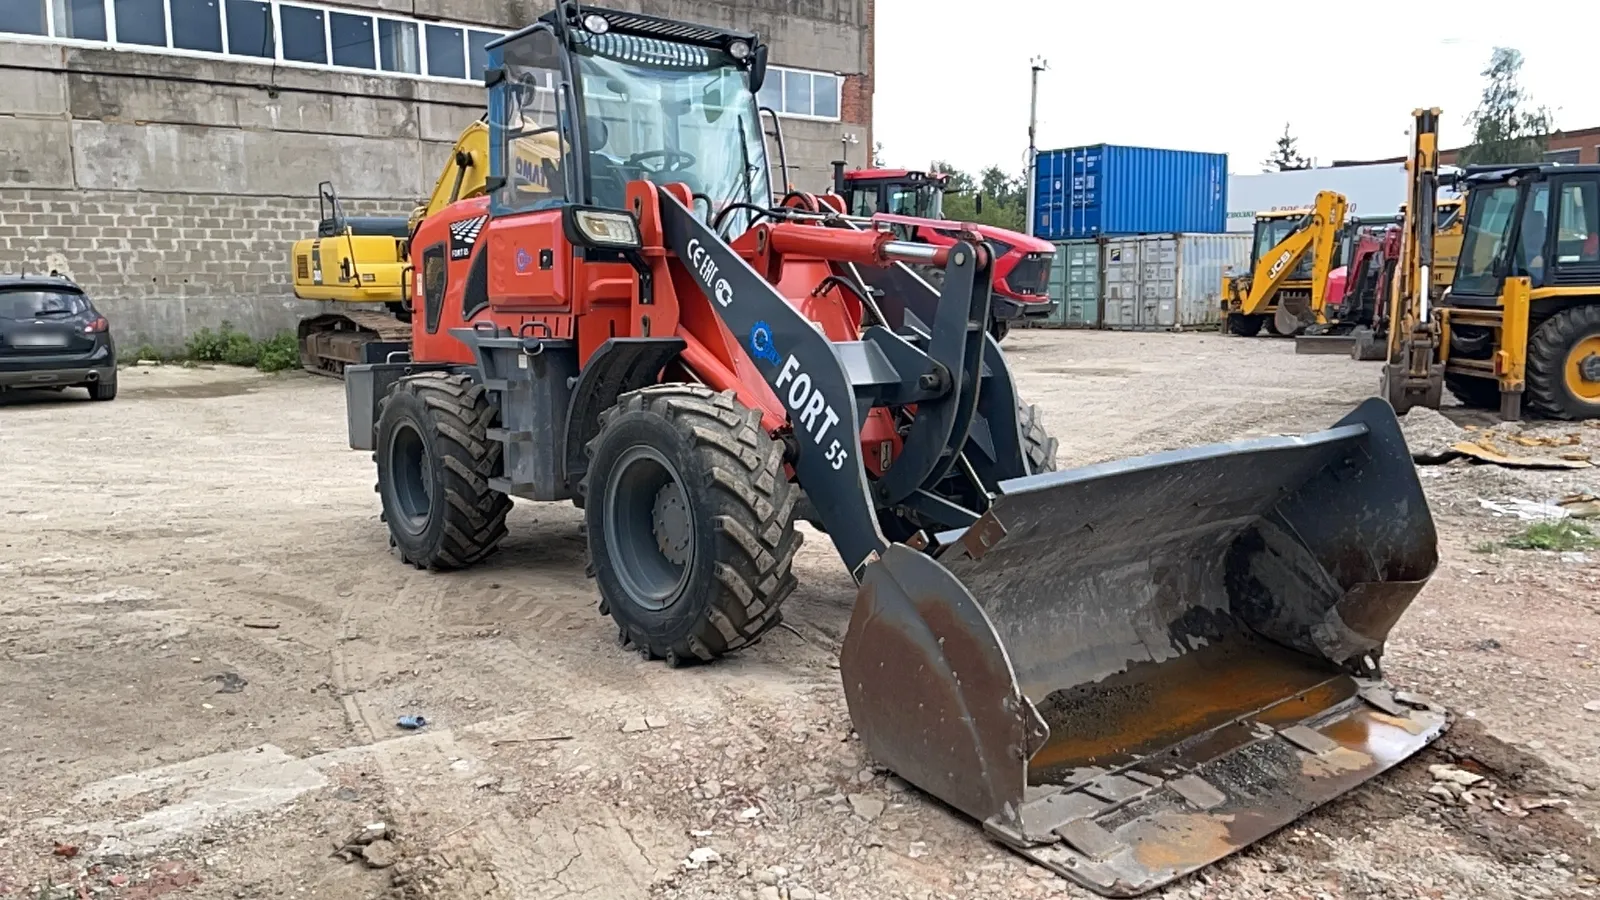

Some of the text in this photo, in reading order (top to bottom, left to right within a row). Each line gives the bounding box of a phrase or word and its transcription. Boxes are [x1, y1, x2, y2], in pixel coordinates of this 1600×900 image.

[1269, 250, 1291, 279] JCB
[775, 353, 848, 470] FORT 55
